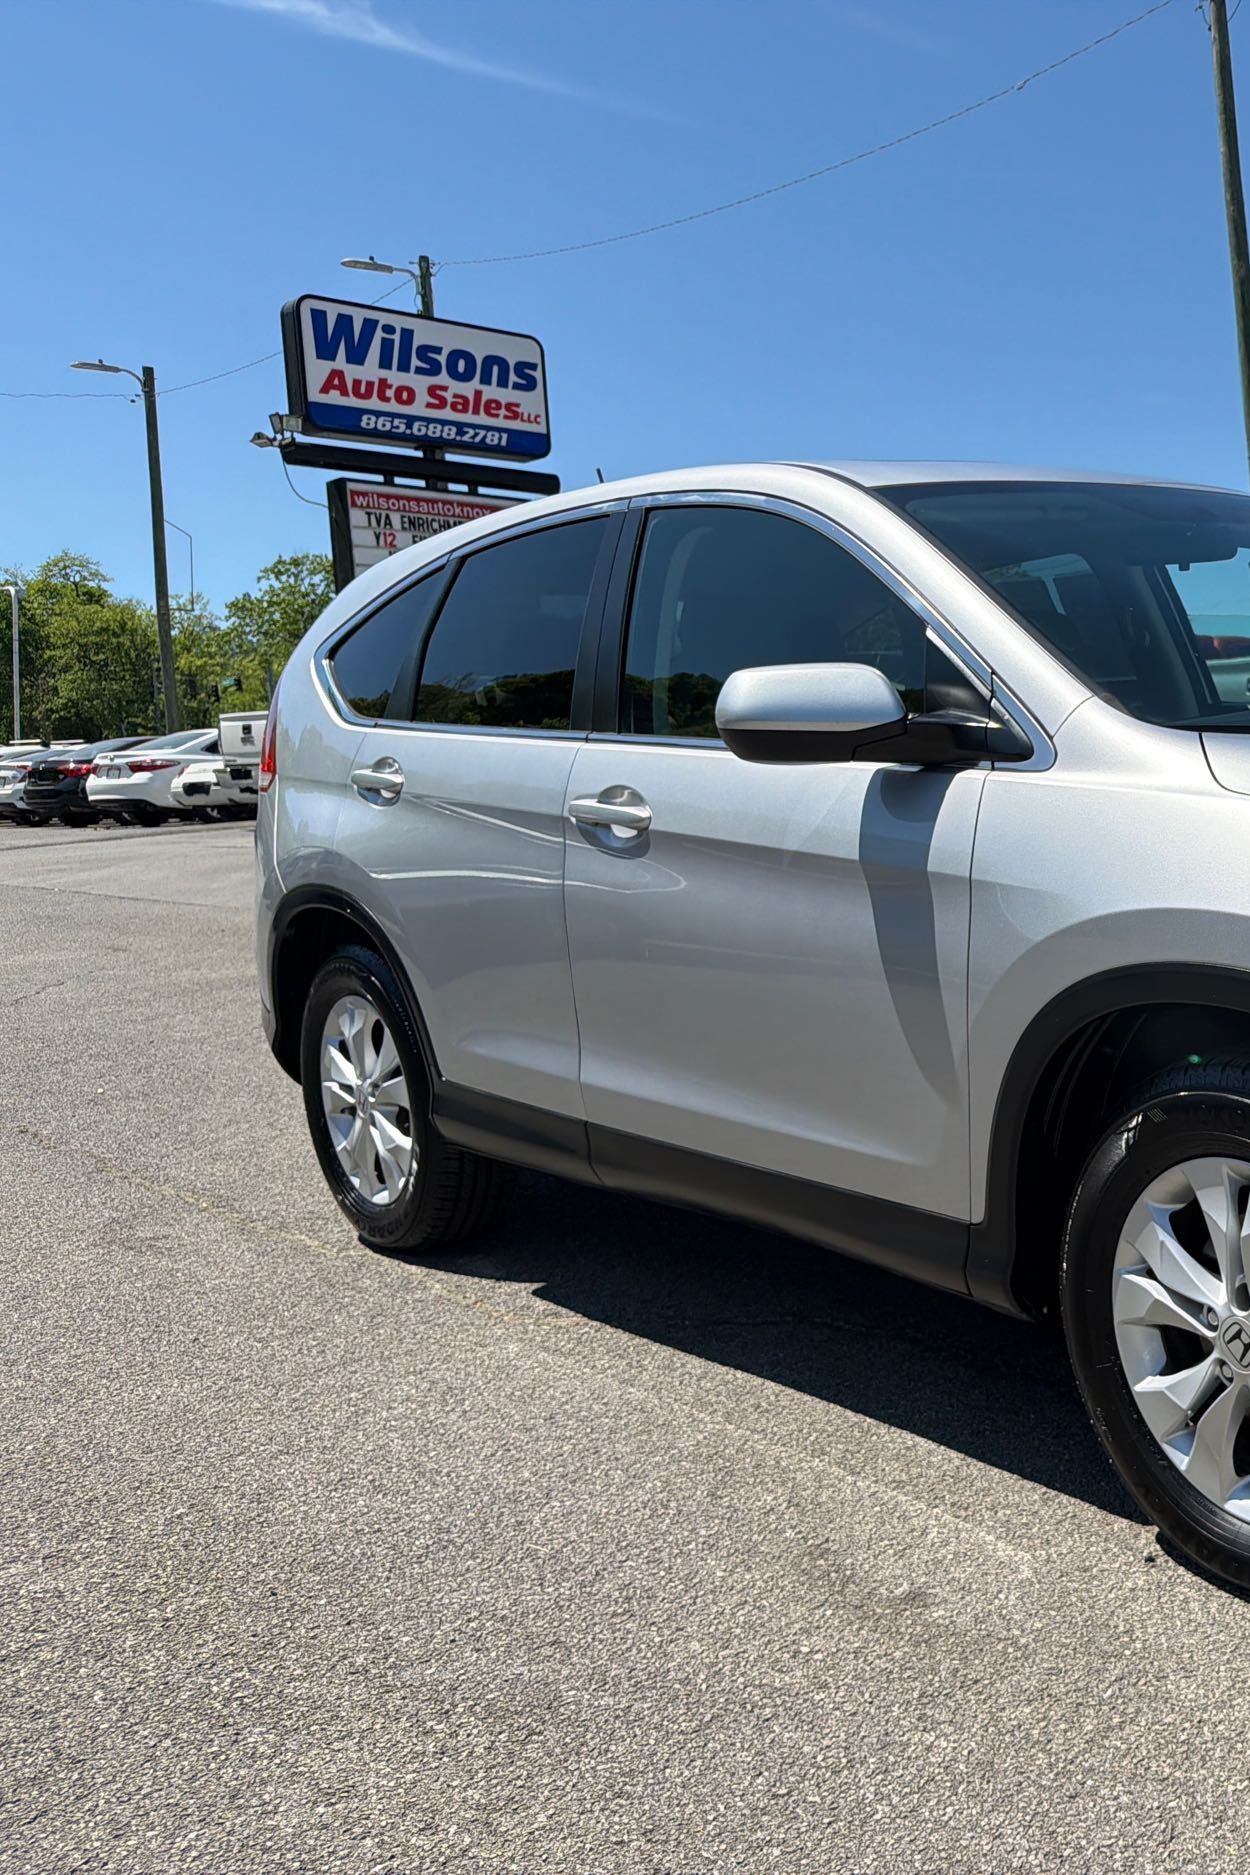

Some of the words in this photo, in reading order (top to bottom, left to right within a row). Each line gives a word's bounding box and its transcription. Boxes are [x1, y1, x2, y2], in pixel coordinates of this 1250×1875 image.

[309, 307, 539, 392] Wilsons
[318, 368, 417, 407] Auto
[424, 384, 521, 421] Sales
[520, 411, 541, 425] LLC
[359, 413, 508, 447] 865.688.2781
[364, 511, 393, 529] TVA
[400, 514, 465, 534] ENRICHM
